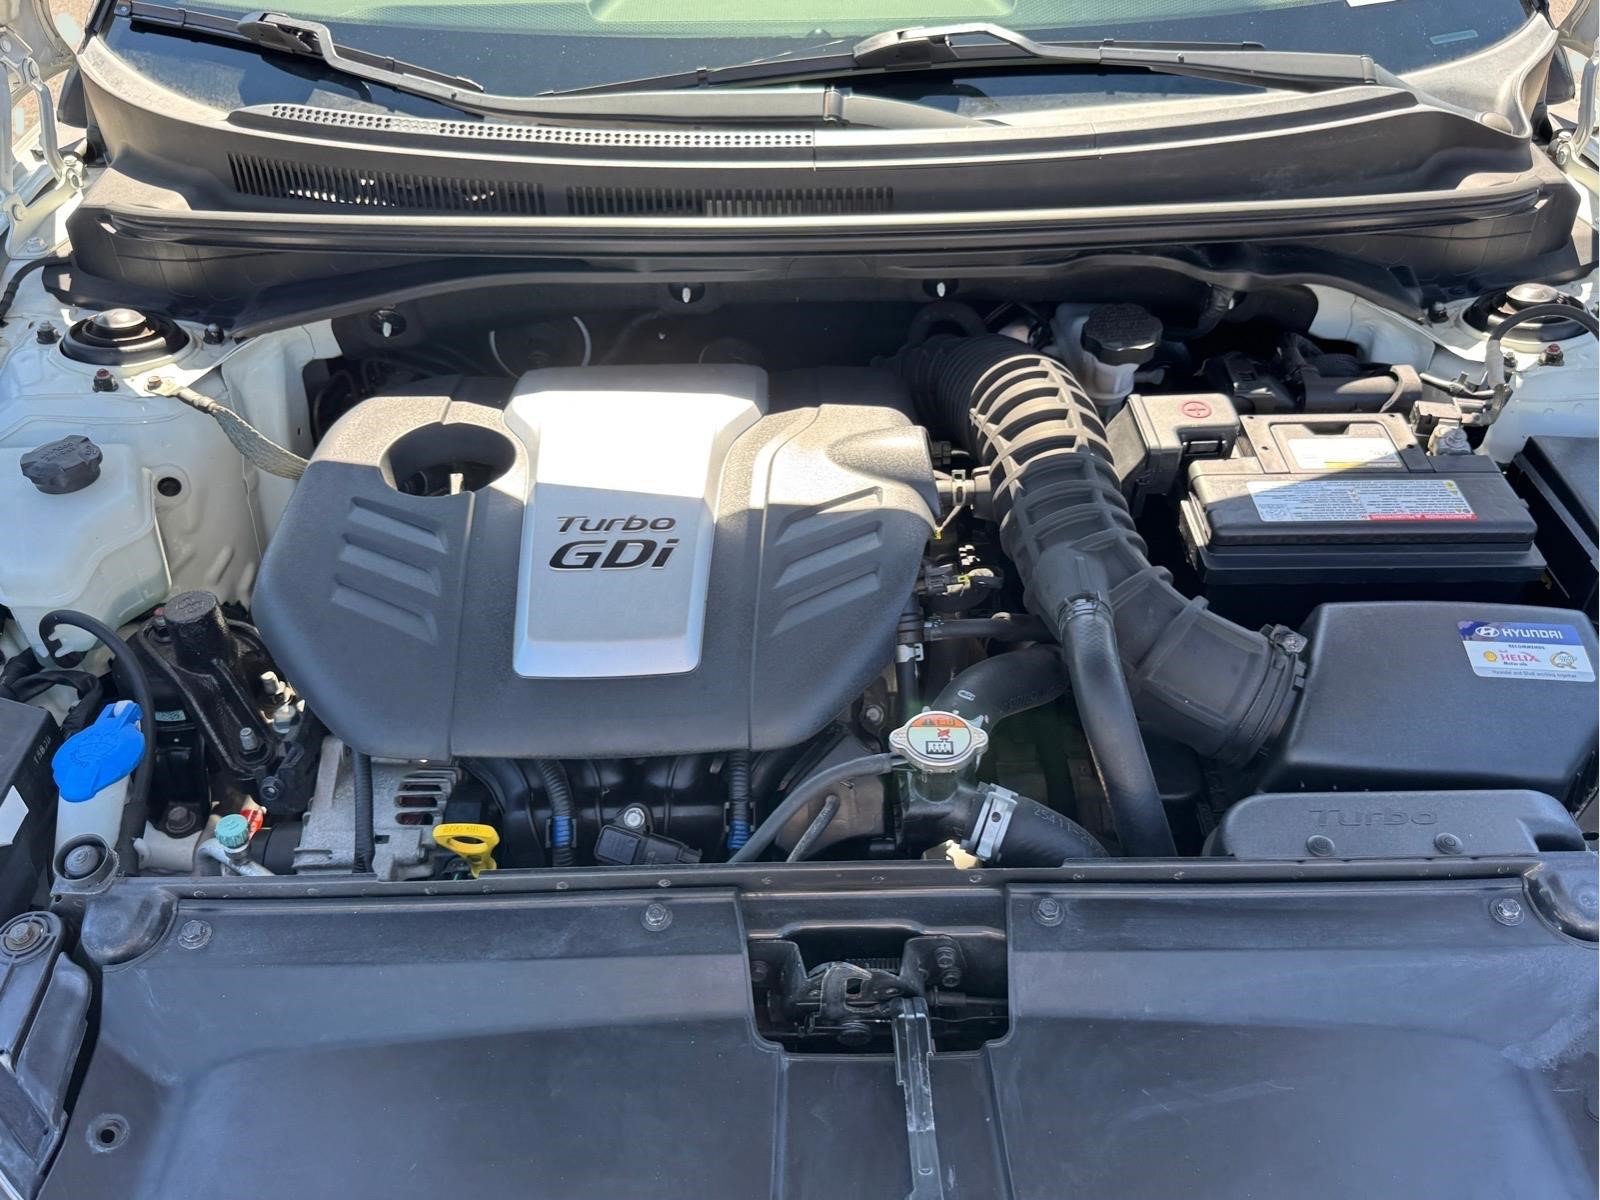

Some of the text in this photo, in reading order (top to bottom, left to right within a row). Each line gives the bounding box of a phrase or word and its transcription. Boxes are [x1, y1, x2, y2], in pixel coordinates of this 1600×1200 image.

[556, 514, 677, 534] Turbo
[548, 538, 681, 571] GDi
[1501, 628, 1563, 639] HYUNDAI
[1500, 653, 1537, 662] HELIX
[1308, 807, 1438, 826] Turbo
